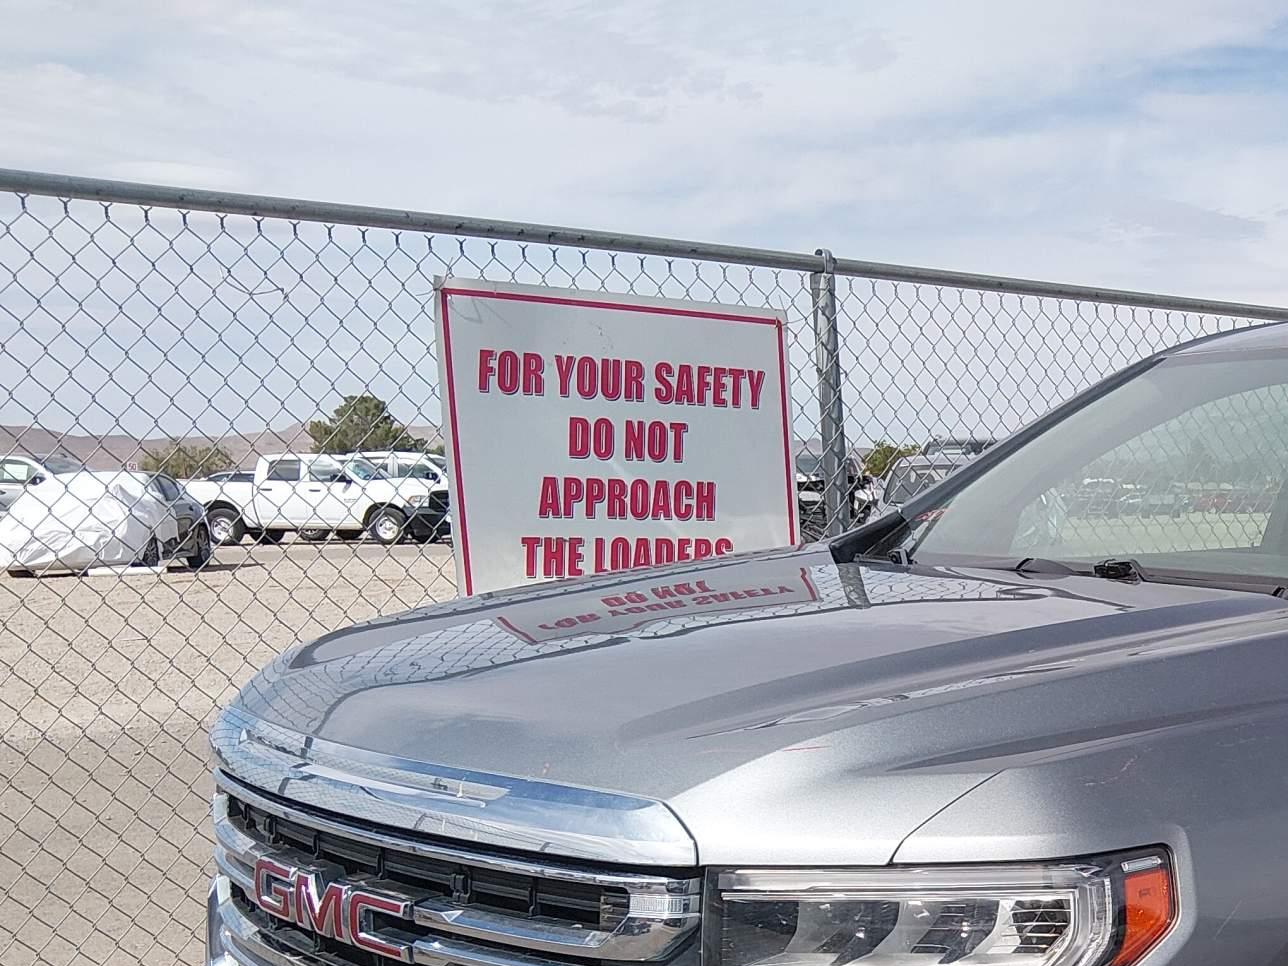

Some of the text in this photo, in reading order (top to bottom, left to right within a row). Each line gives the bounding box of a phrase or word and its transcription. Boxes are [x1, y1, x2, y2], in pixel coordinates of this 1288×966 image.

[478, 349, 765, 409] FOR YOUR SAFETY
[568, 416, 688, 463] DO NOT
[538, 476, 717, 521] APPROACH
[520, 536, 584, 578] THE
[255, 856, 412, 964] GMC
